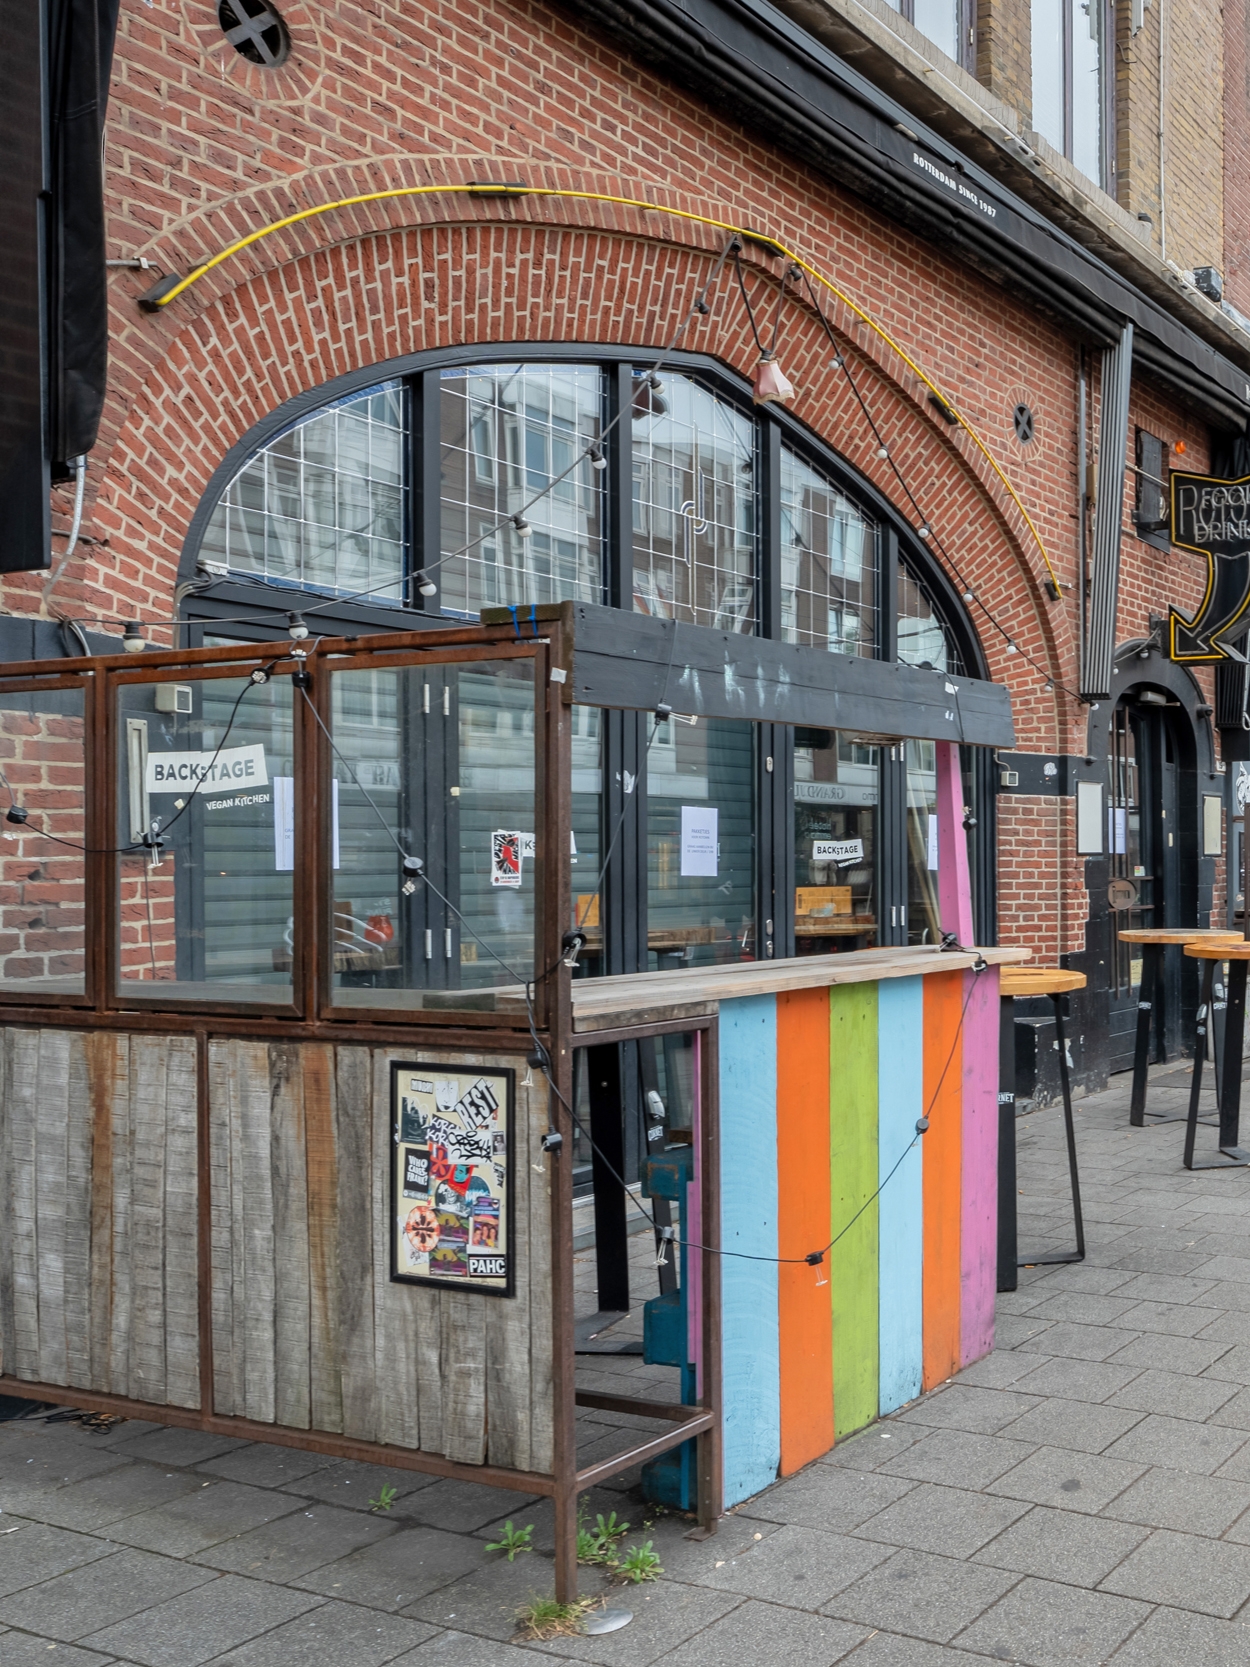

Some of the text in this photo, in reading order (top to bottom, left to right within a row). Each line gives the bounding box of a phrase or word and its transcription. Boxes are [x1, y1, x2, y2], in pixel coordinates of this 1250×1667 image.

[913, 152, 996, 218] ROTTERDAM SINCE 1987
[154, 758, 255, 783] BACKSTAGE
[206, 793, 270, 811] VEGAN KITCHEN
[817, 845, 858, 855] BACKSTAGE
[407, 1154, 429, 1169] WHO
[469, 1259, 506, 1273] PAHC
